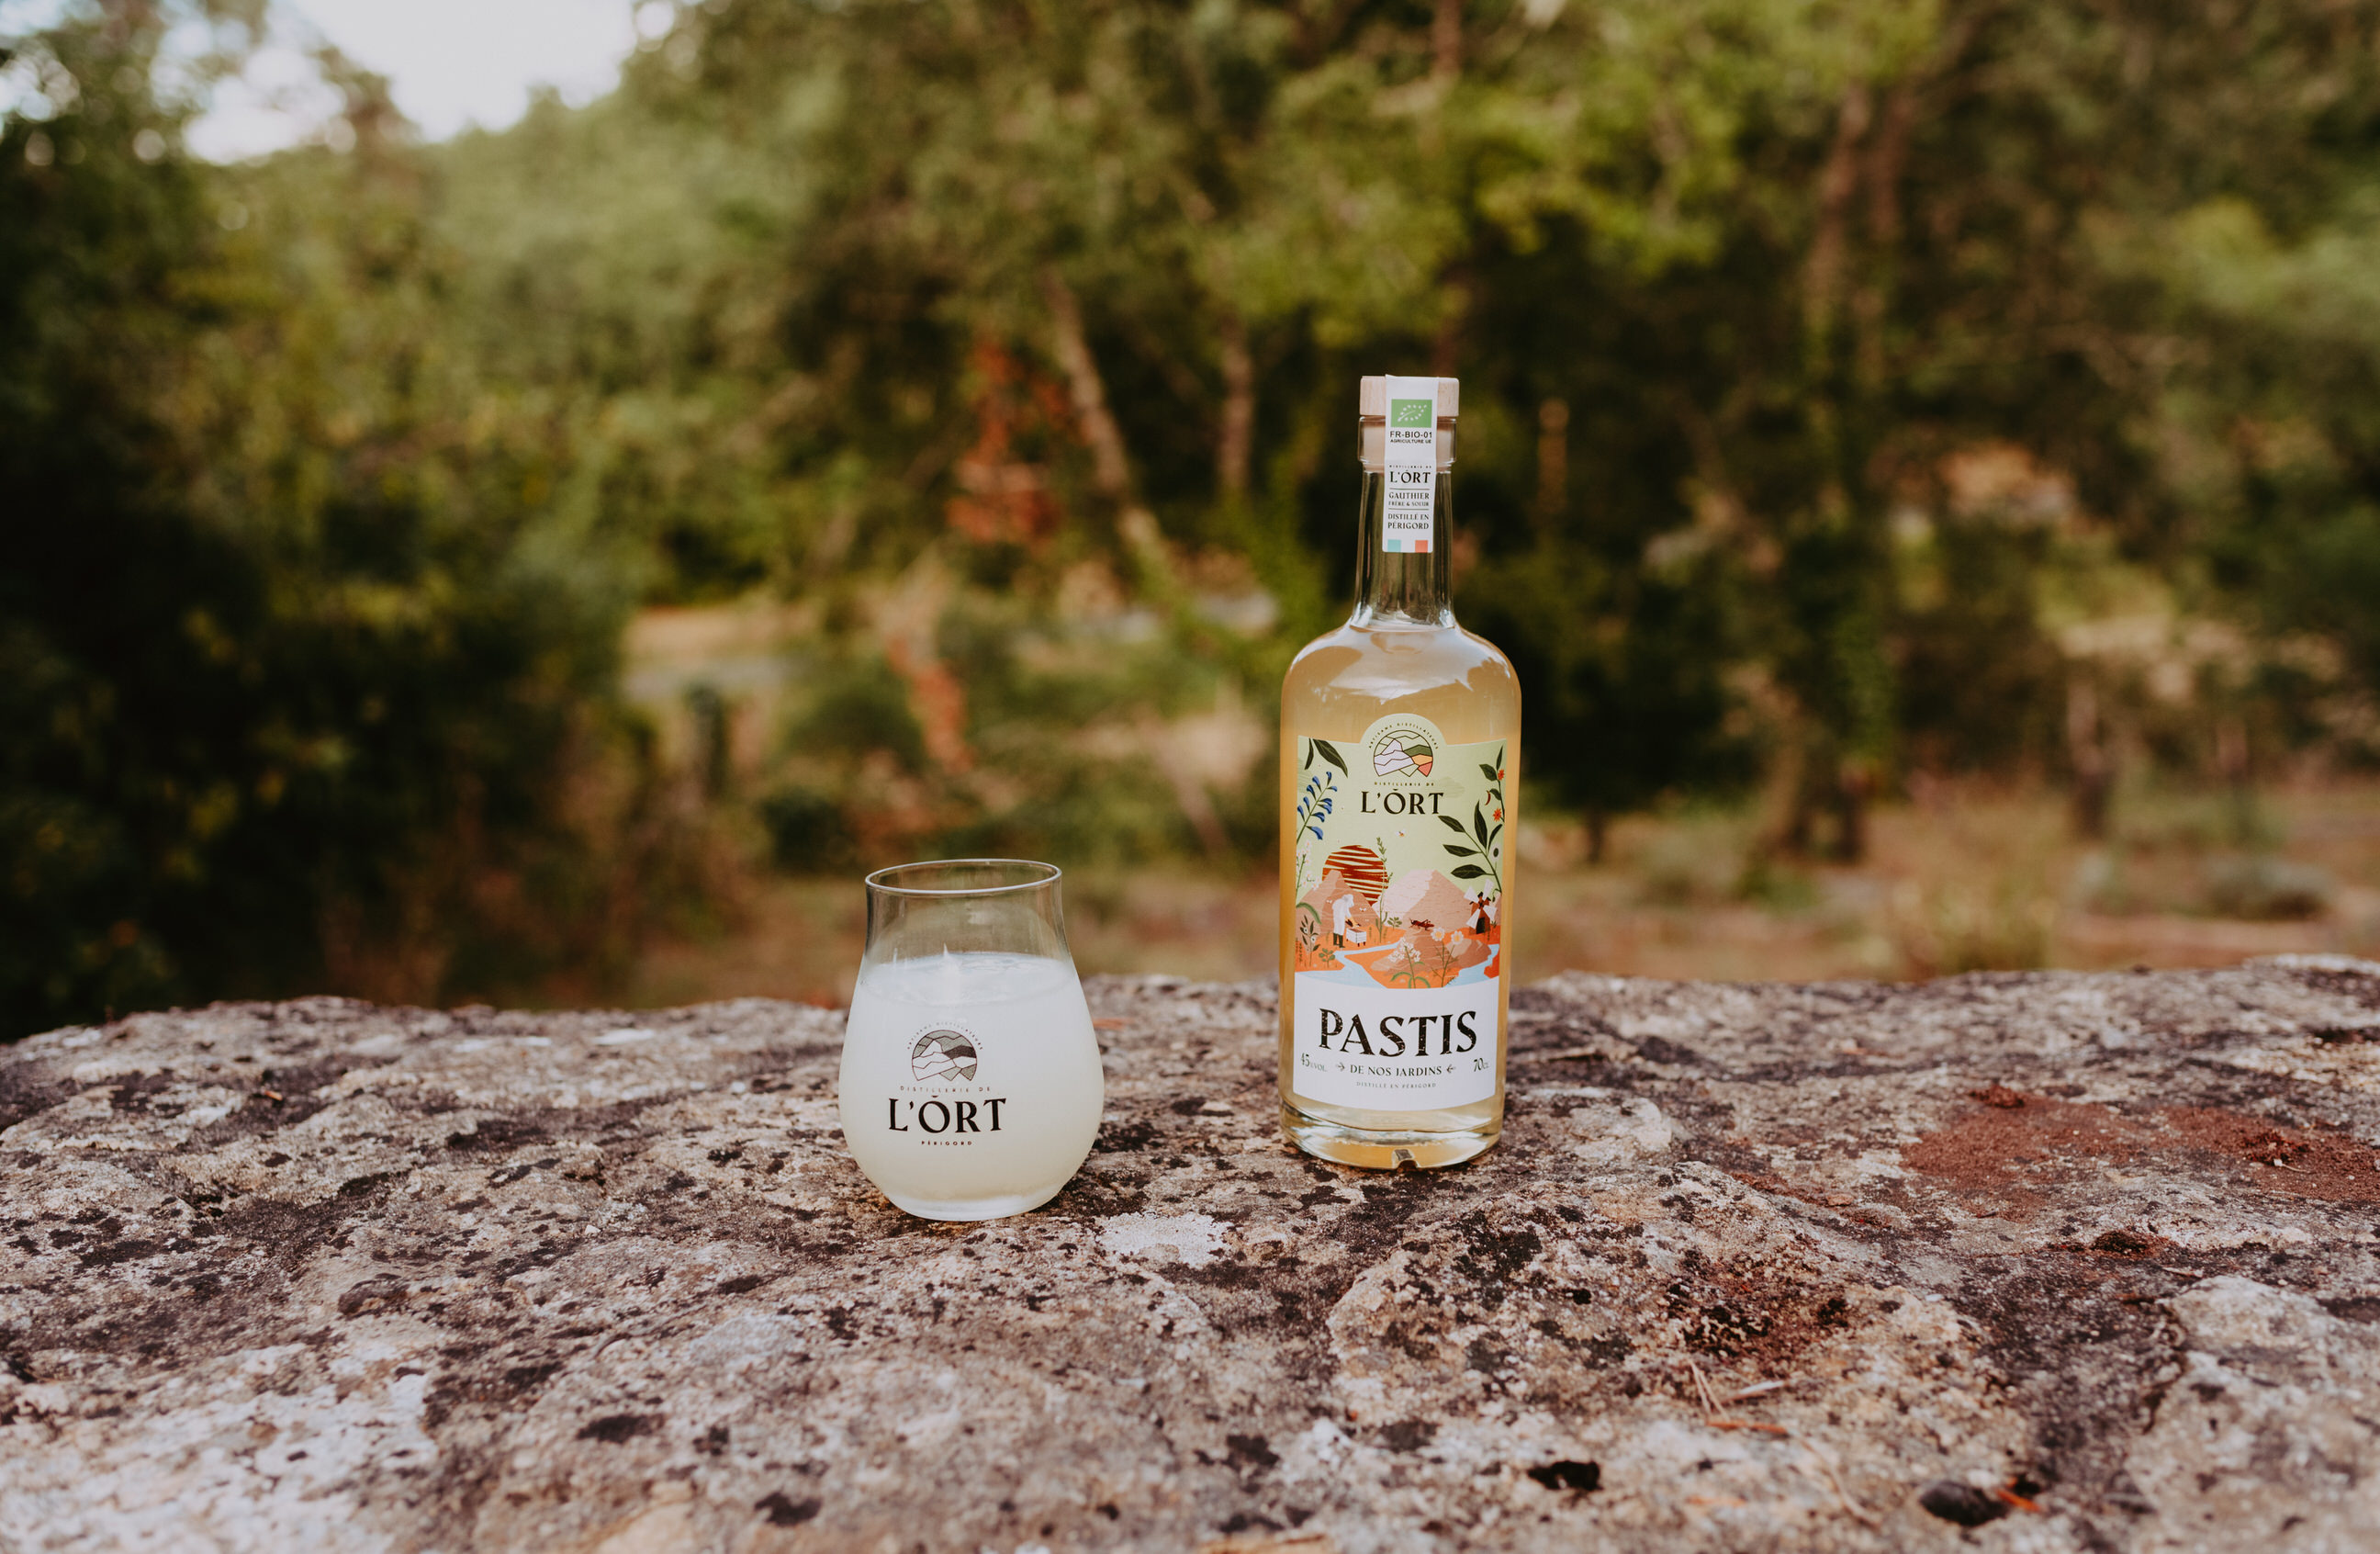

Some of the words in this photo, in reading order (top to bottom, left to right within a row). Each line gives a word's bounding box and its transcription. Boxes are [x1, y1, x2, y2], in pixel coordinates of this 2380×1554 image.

[1387, 521, 1430, 530] PÉRIGORD
[1319, 1008, 1476, 1057] PASTIS
[1350, 1064, 1364, 1075] DE
[1368, 1066, 1392, 1076] NOS
[1396, 1066, 1443, 1076] JARDINS
